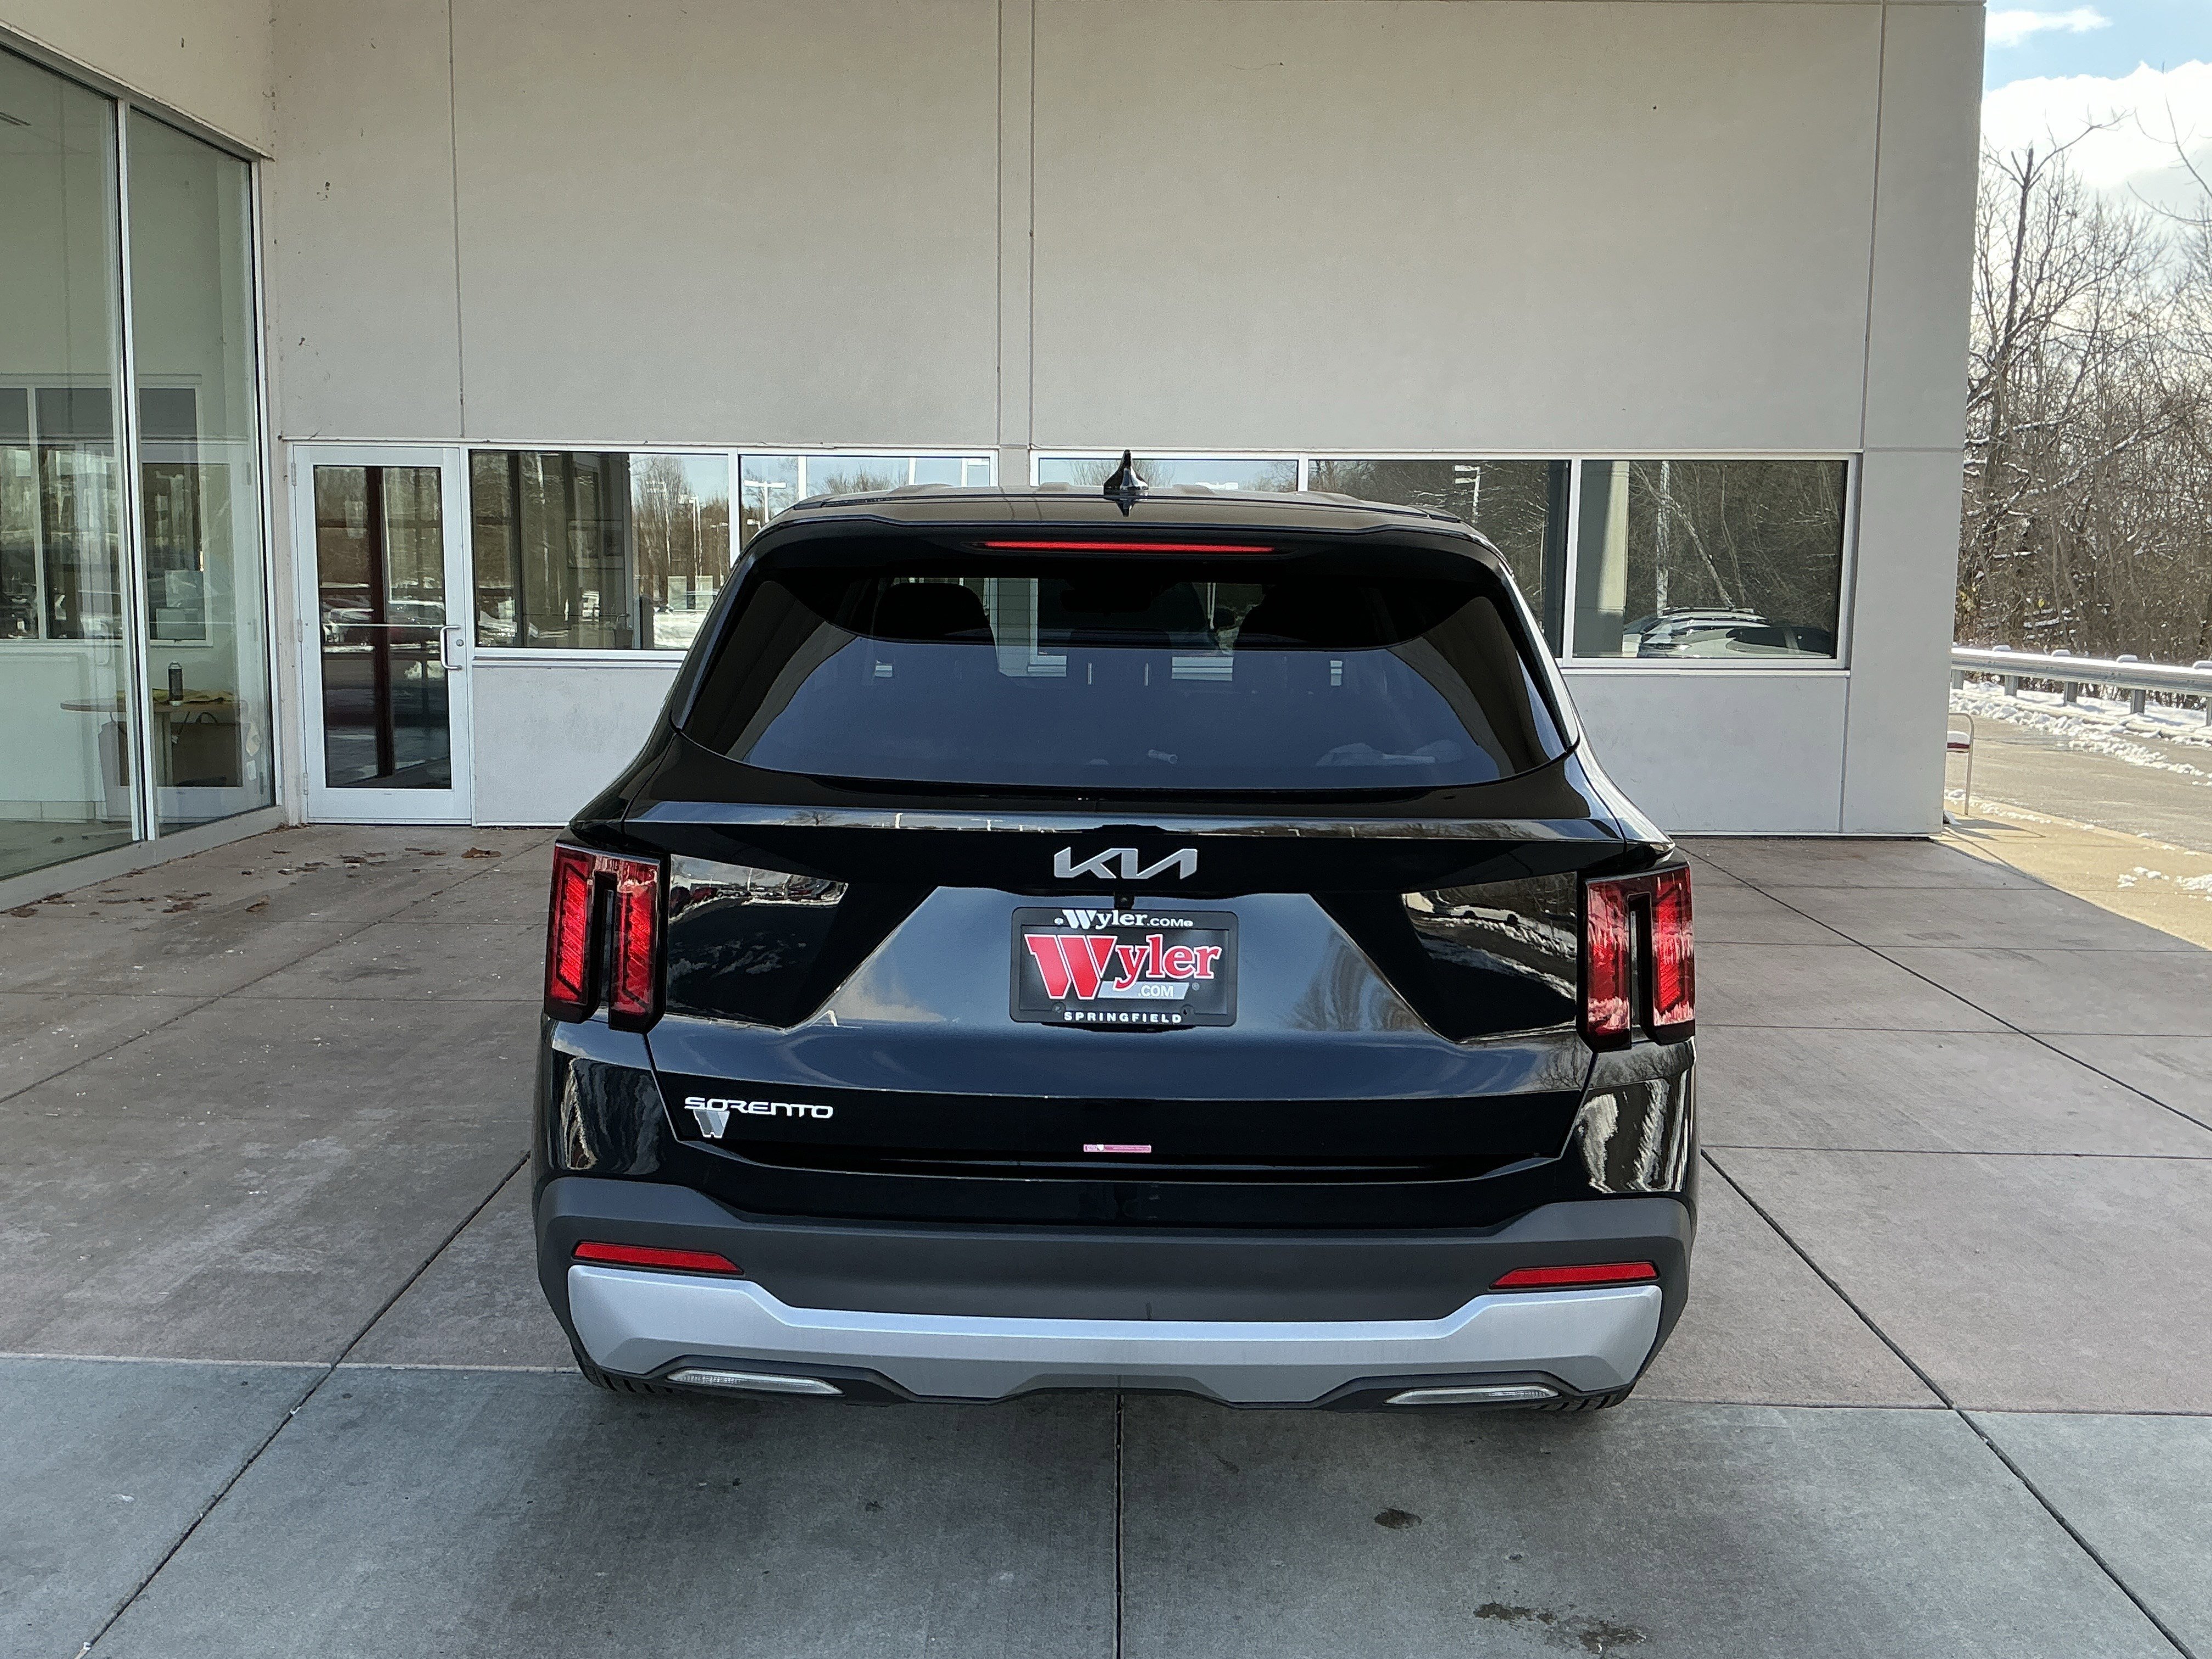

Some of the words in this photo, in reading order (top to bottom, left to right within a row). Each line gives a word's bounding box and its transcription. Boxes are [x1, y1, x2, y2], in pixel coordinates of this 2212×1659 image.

[1024, 934, 1222, 1000] Wyler
[1064, 1011, 1182, 1024] SPRINGFIELD
[684, 1096, 834, 1119] SORENTO
